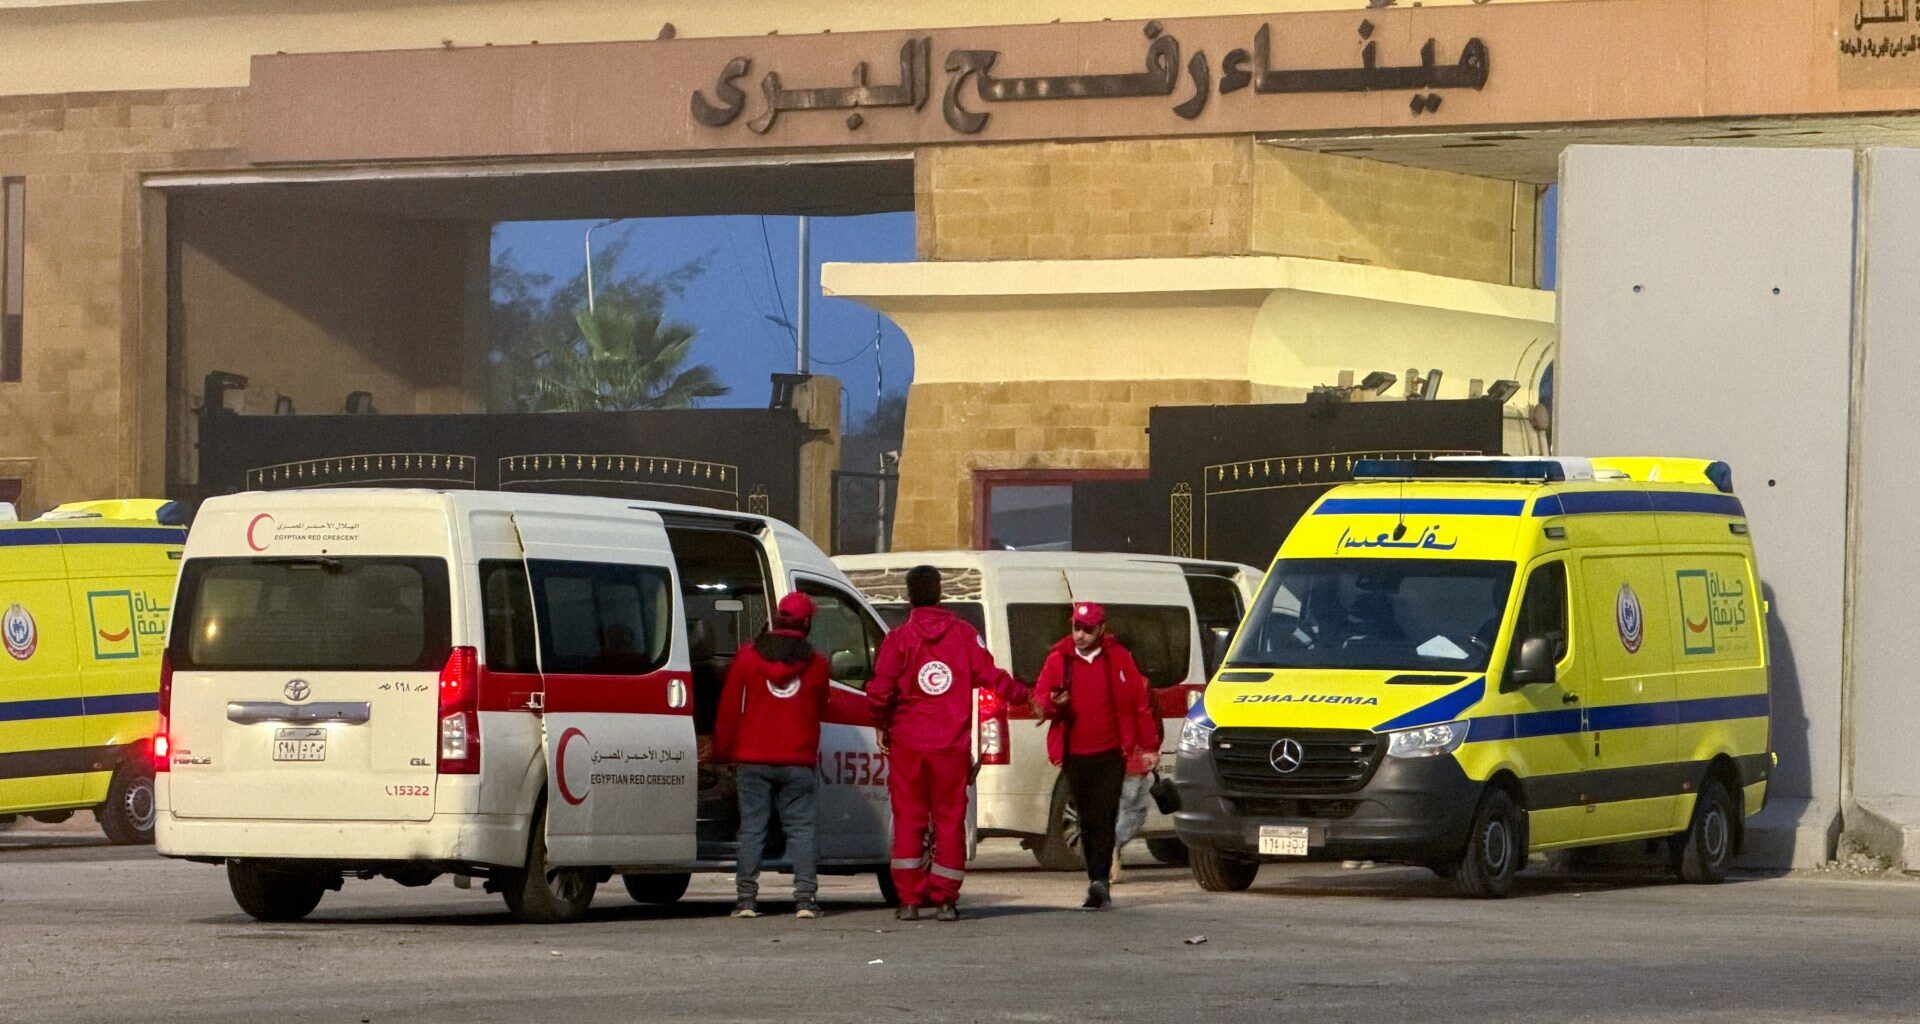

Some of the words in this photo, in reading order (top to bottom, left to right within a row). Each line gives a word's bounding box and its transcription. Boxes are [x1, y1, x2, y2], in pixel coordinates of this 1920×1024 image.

[1219, 19, 1490, 117] ميناء
[942, 20, 1210, 134] رفح
[410, 758, 431, 766] GL
[624, 746, 657, 763] الأحمر
[834, 751, 888, 786] 1532
[590, 773, 628, 785] EGYPTIAN
[629, 774, 645, 785] RED
[646, 774, 685, 786] CRESCENT
[393, 785, 430, 797] 15322
